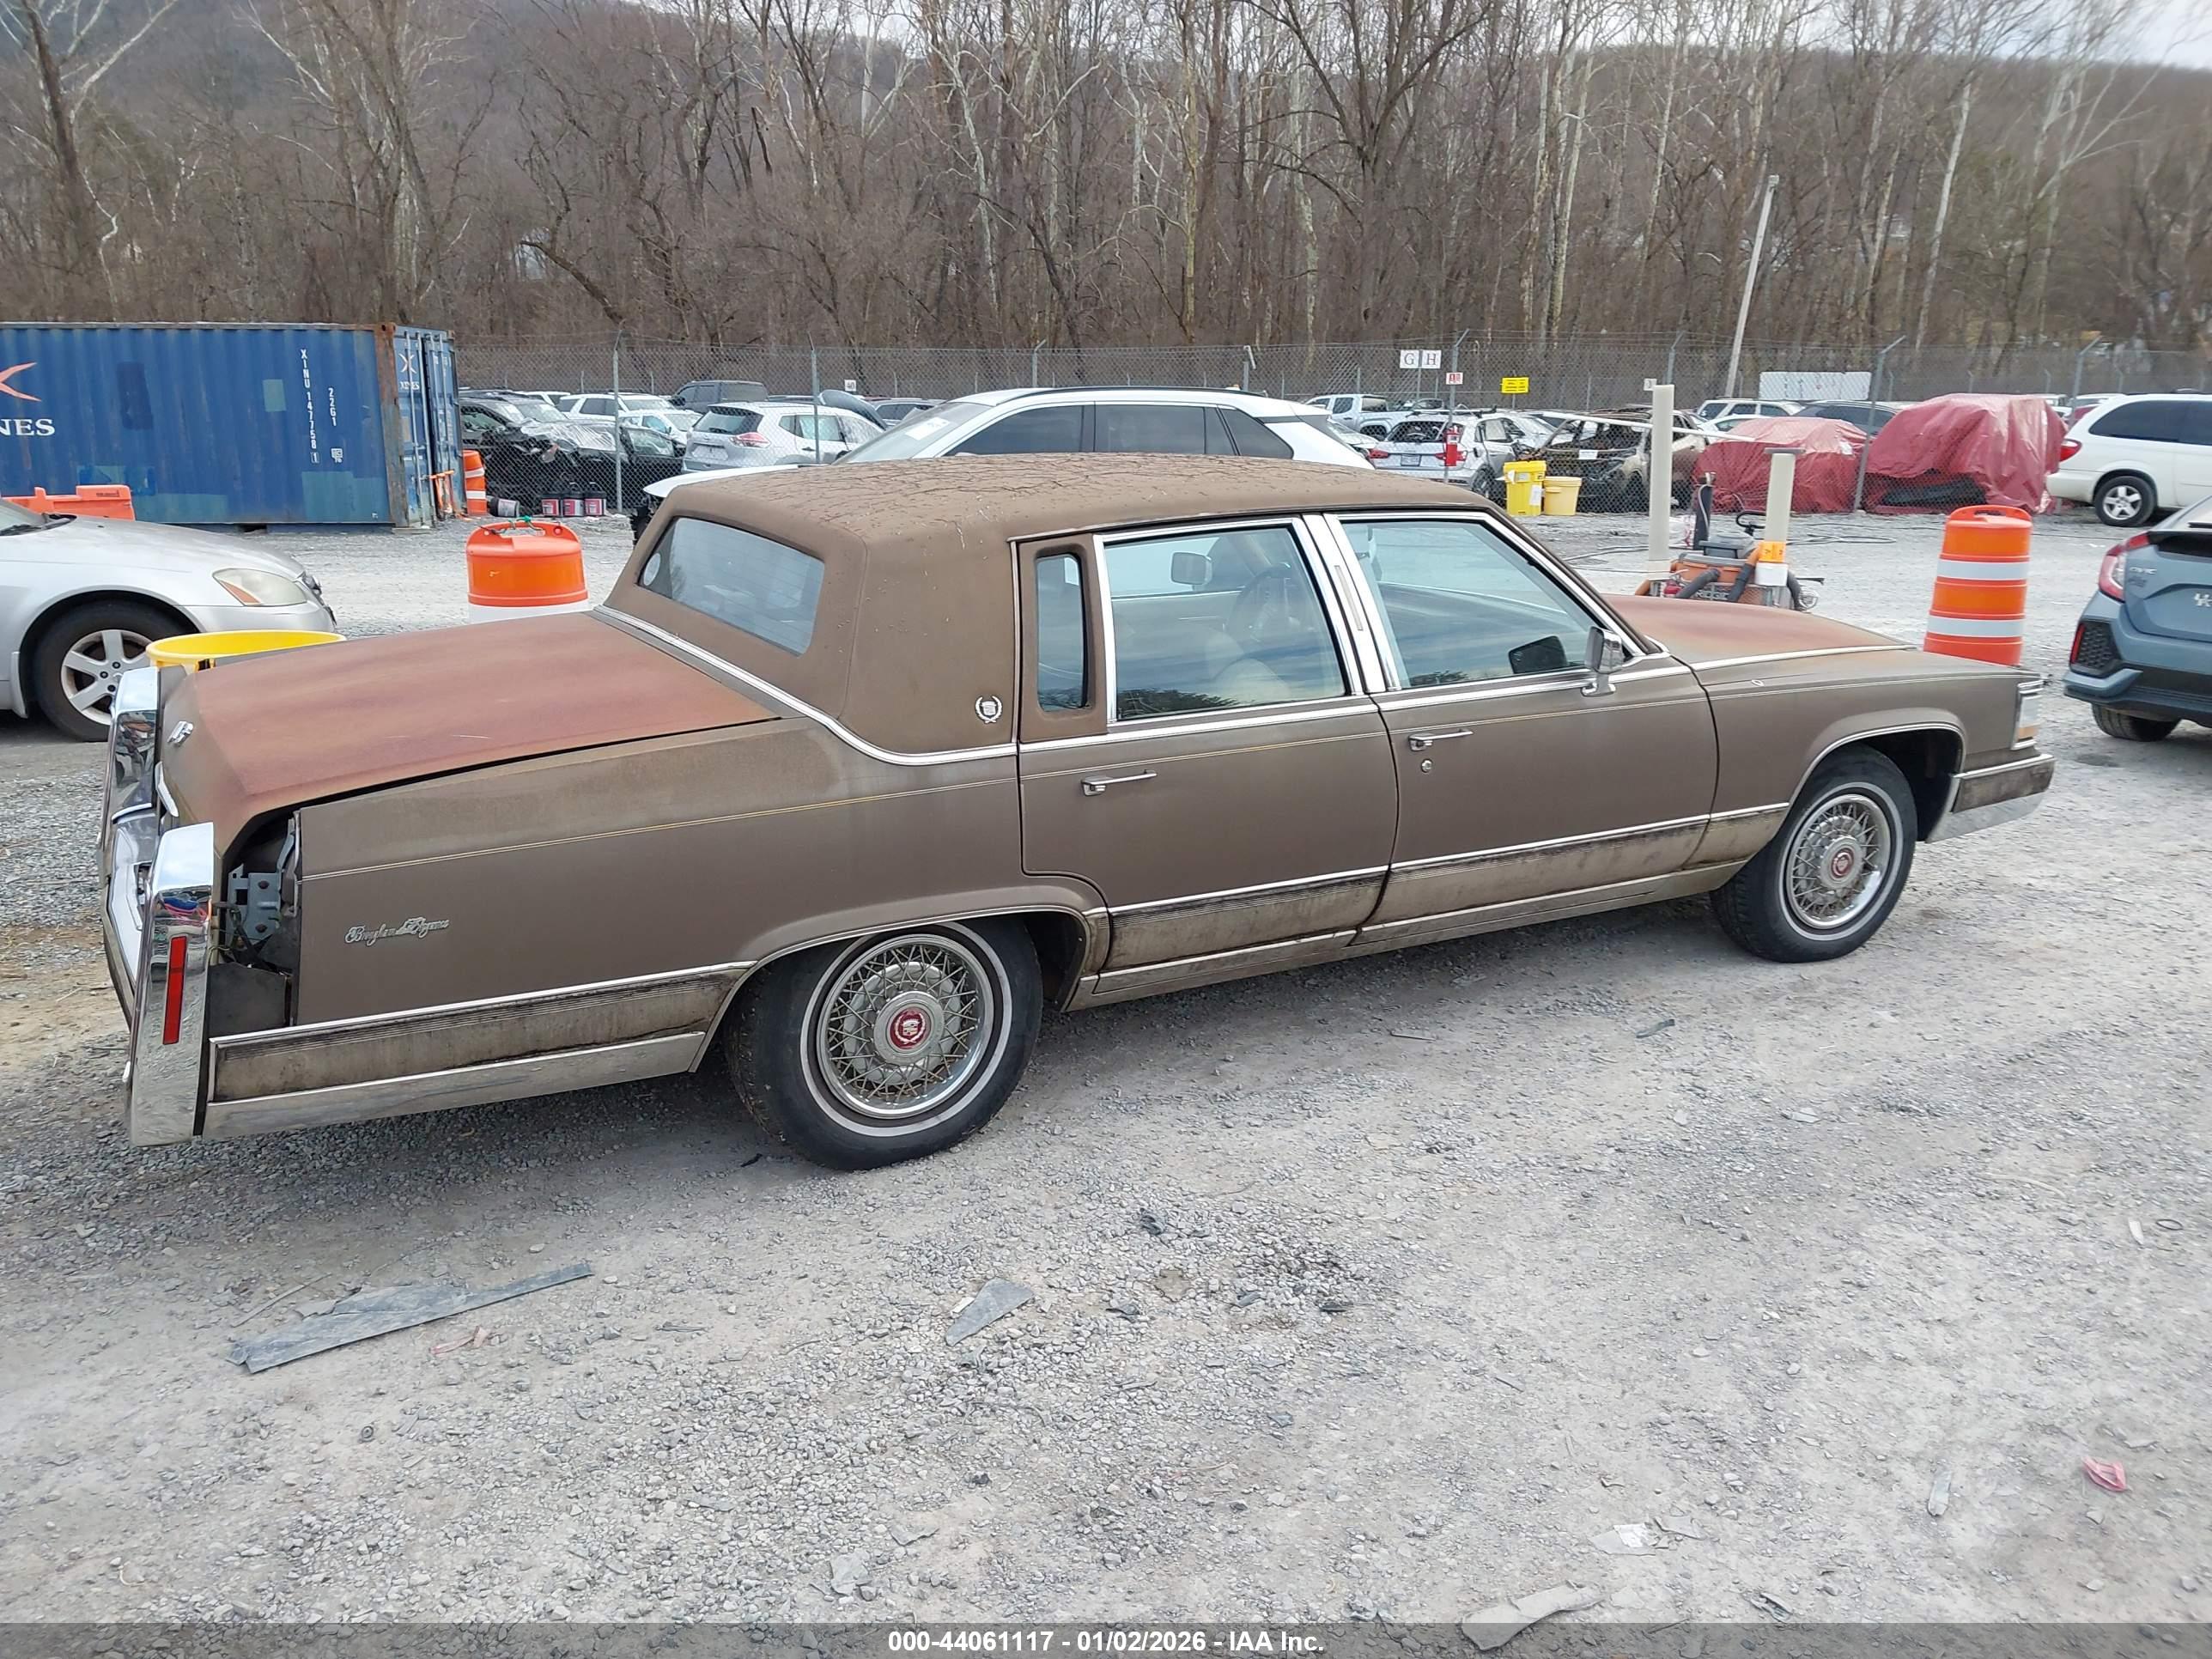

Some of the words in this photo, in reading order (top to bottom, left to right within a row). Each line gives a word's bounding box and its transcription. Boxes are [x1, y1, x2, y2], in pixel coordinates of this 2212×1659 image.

[1403, 352, 1415, 366] G
[1425, 352, 1437, 366] H
[307, 392, 317, 449] 147758
[327, 387, 337, 427] 22G1
